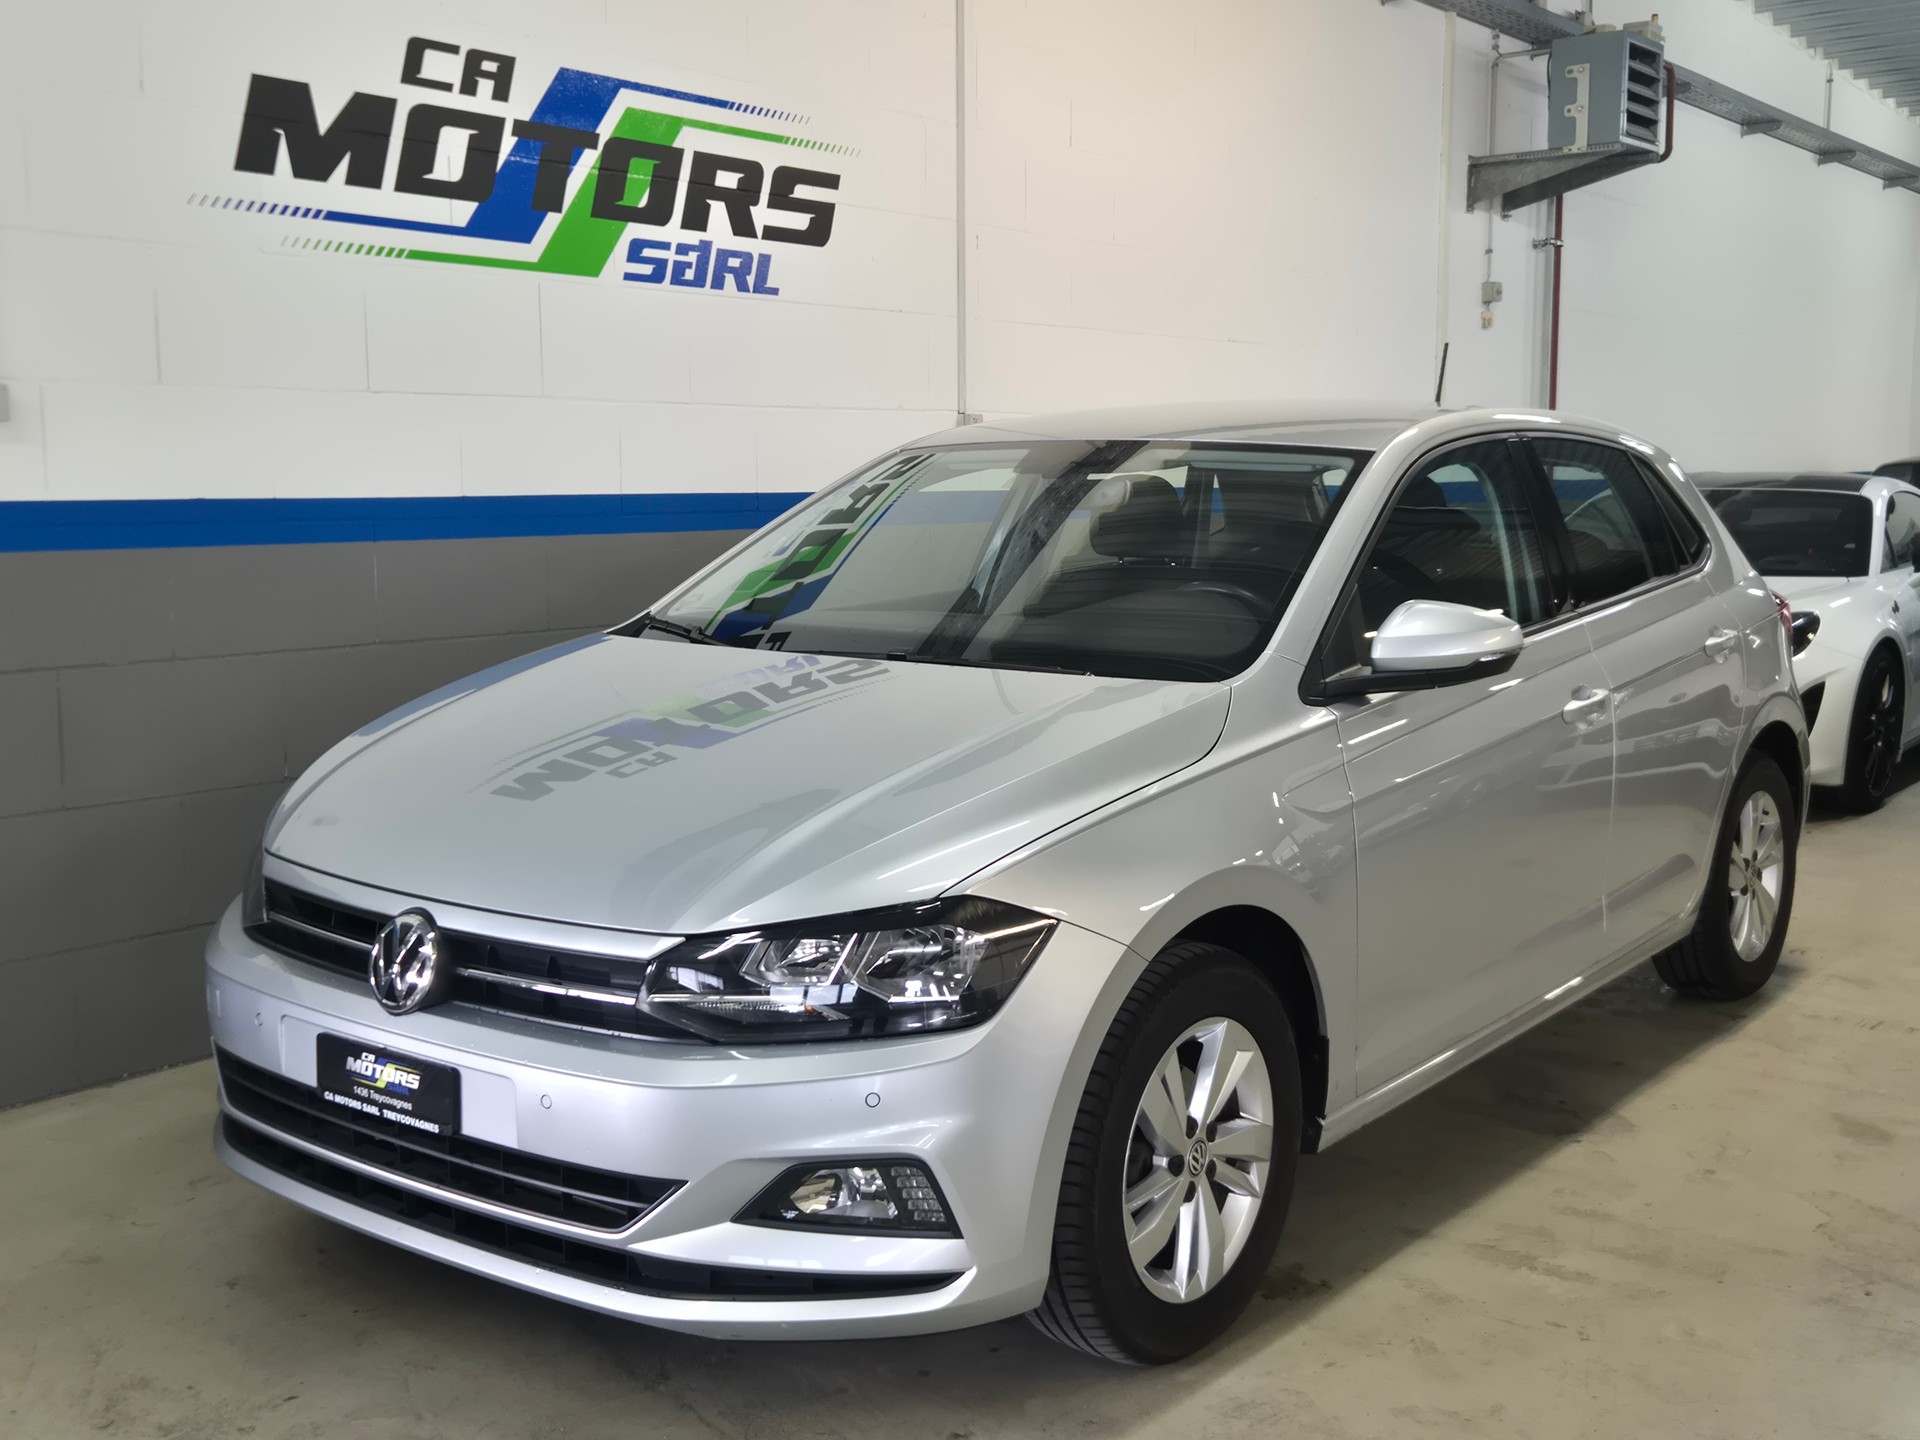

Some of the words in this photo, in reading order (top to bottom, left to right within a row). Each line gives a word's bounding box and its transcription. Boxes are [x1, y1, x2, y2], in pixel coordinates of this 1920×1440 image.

[400, 36, 517, 103] CA
[233, 72, 842, 248] MOTORS
[346, 1056, 421, 1090] MOTORS
[361, 1052, 376, 1063] CA
[323, 1091, 334, 1102] CA
[334, 1094, 362, 1111] MOTORS
[362, 1102, 380, 1116] SARL
[382, 1109, 439, 1134] TREYCOVAGNES
[369, 1089, 412, 1111] Treycovagnes
